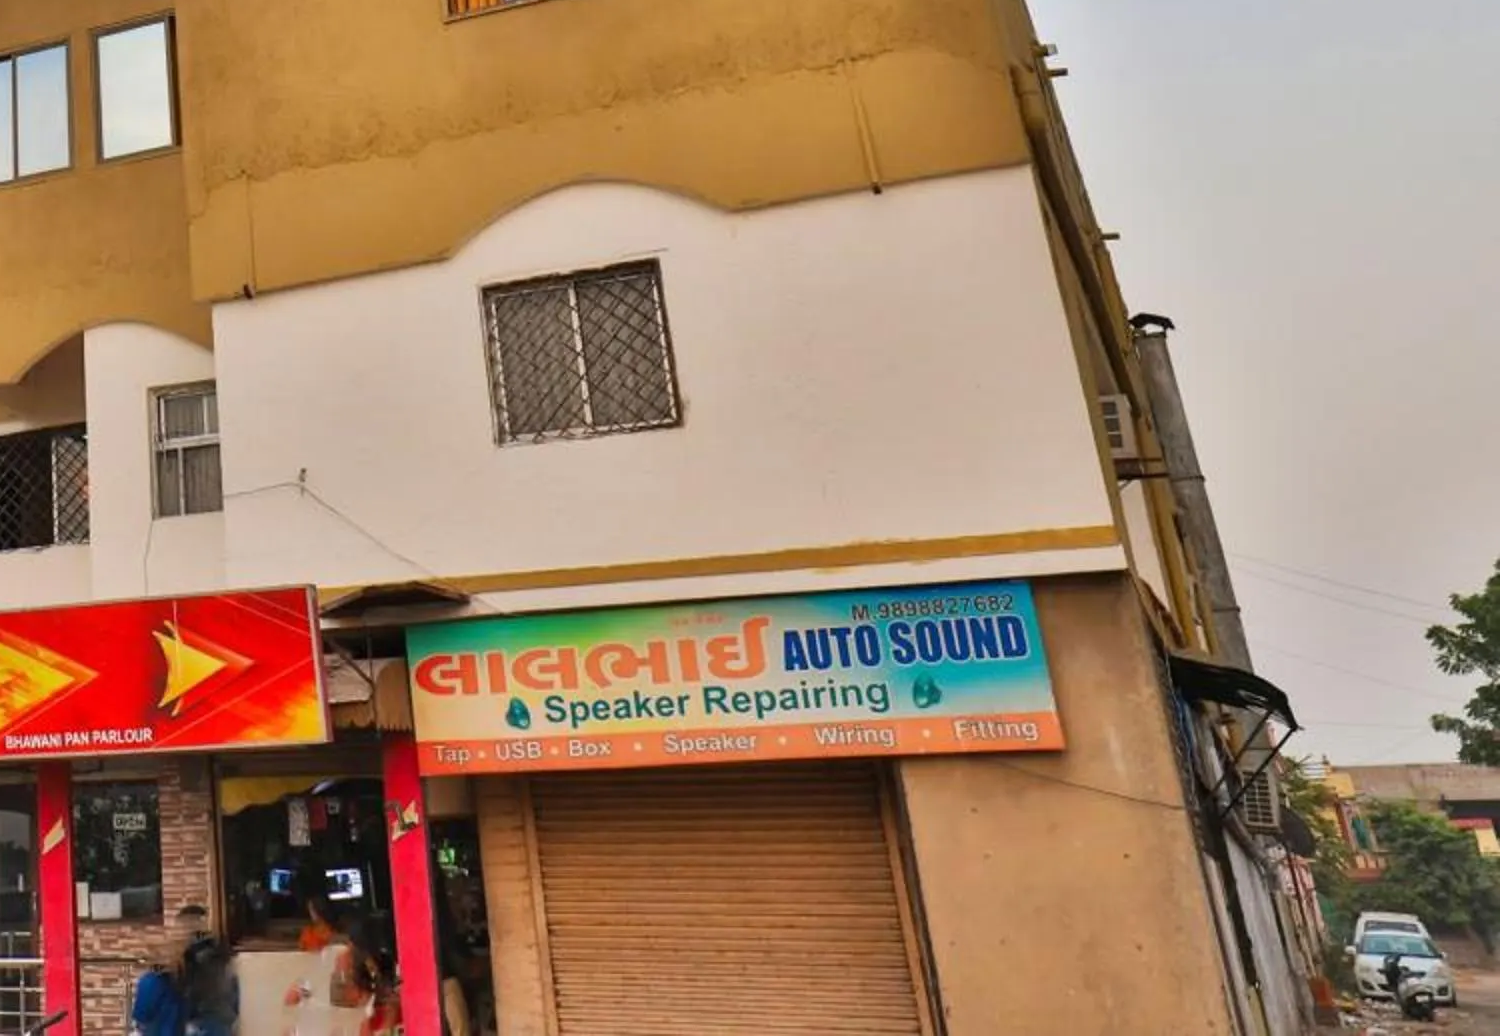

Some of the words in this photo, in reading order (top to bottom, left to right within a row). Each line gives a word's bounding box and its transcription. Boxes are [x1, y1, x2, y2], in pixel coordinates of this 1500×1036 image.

[415, 616, 770, 696] લાલભાઈ
[784, 624, 882, 671] AUTO
[889, 615, 1028, 665] SOUND
[544, 691, 690, 728] Speaker
[703, 679, 890, 719] Repairing
[5, 733, 63, 749] BHAWANI
[64, 731, 89, 746] PAN
[92, 727, 153, 744] PARLOUR
[434, 745, 469, 763] Tap
[495, 741, 542, 760] USB
[568, 739, 612, 757] Box
[663, 733, 757, 753] Speaker
[814, 724, 894, 746] Wiring
[954, 720, 1038, 741] Fitting
